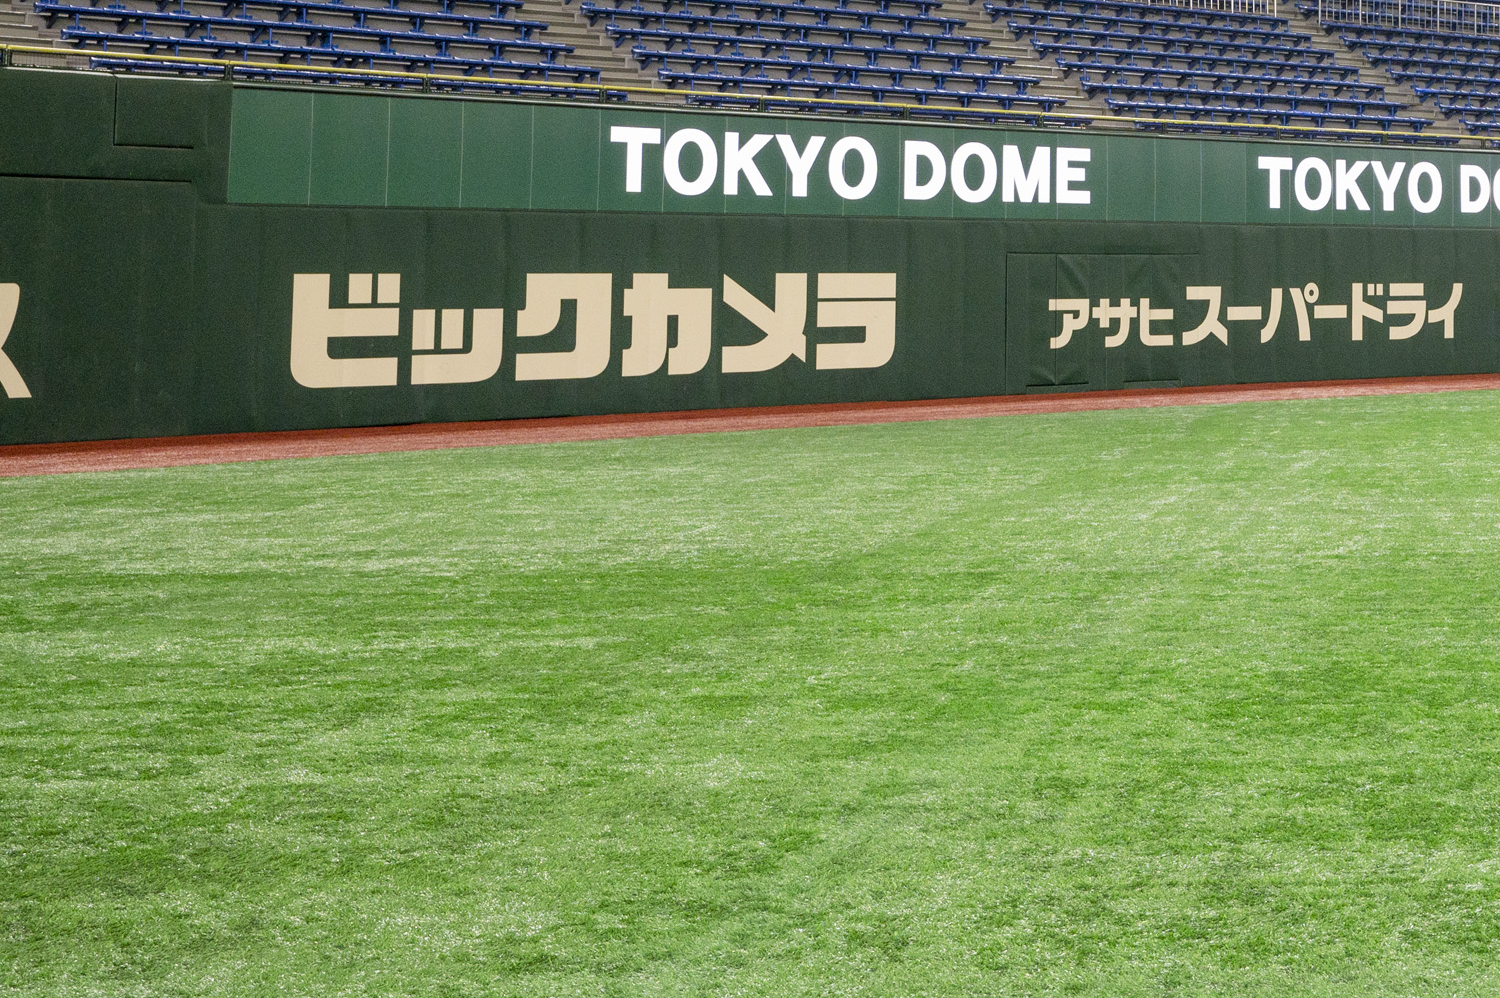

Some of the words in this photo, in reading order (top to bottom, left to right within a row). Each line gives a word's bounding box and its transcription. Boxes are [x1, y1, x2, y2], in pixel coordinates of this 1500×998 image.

[611, 125, 878, 201] TOKYO
[903, 140, 1091, 204] DOME
[1258, 156, 1442, 214] TOKYO
[289, 273, 897, 389] ビックカメラ
